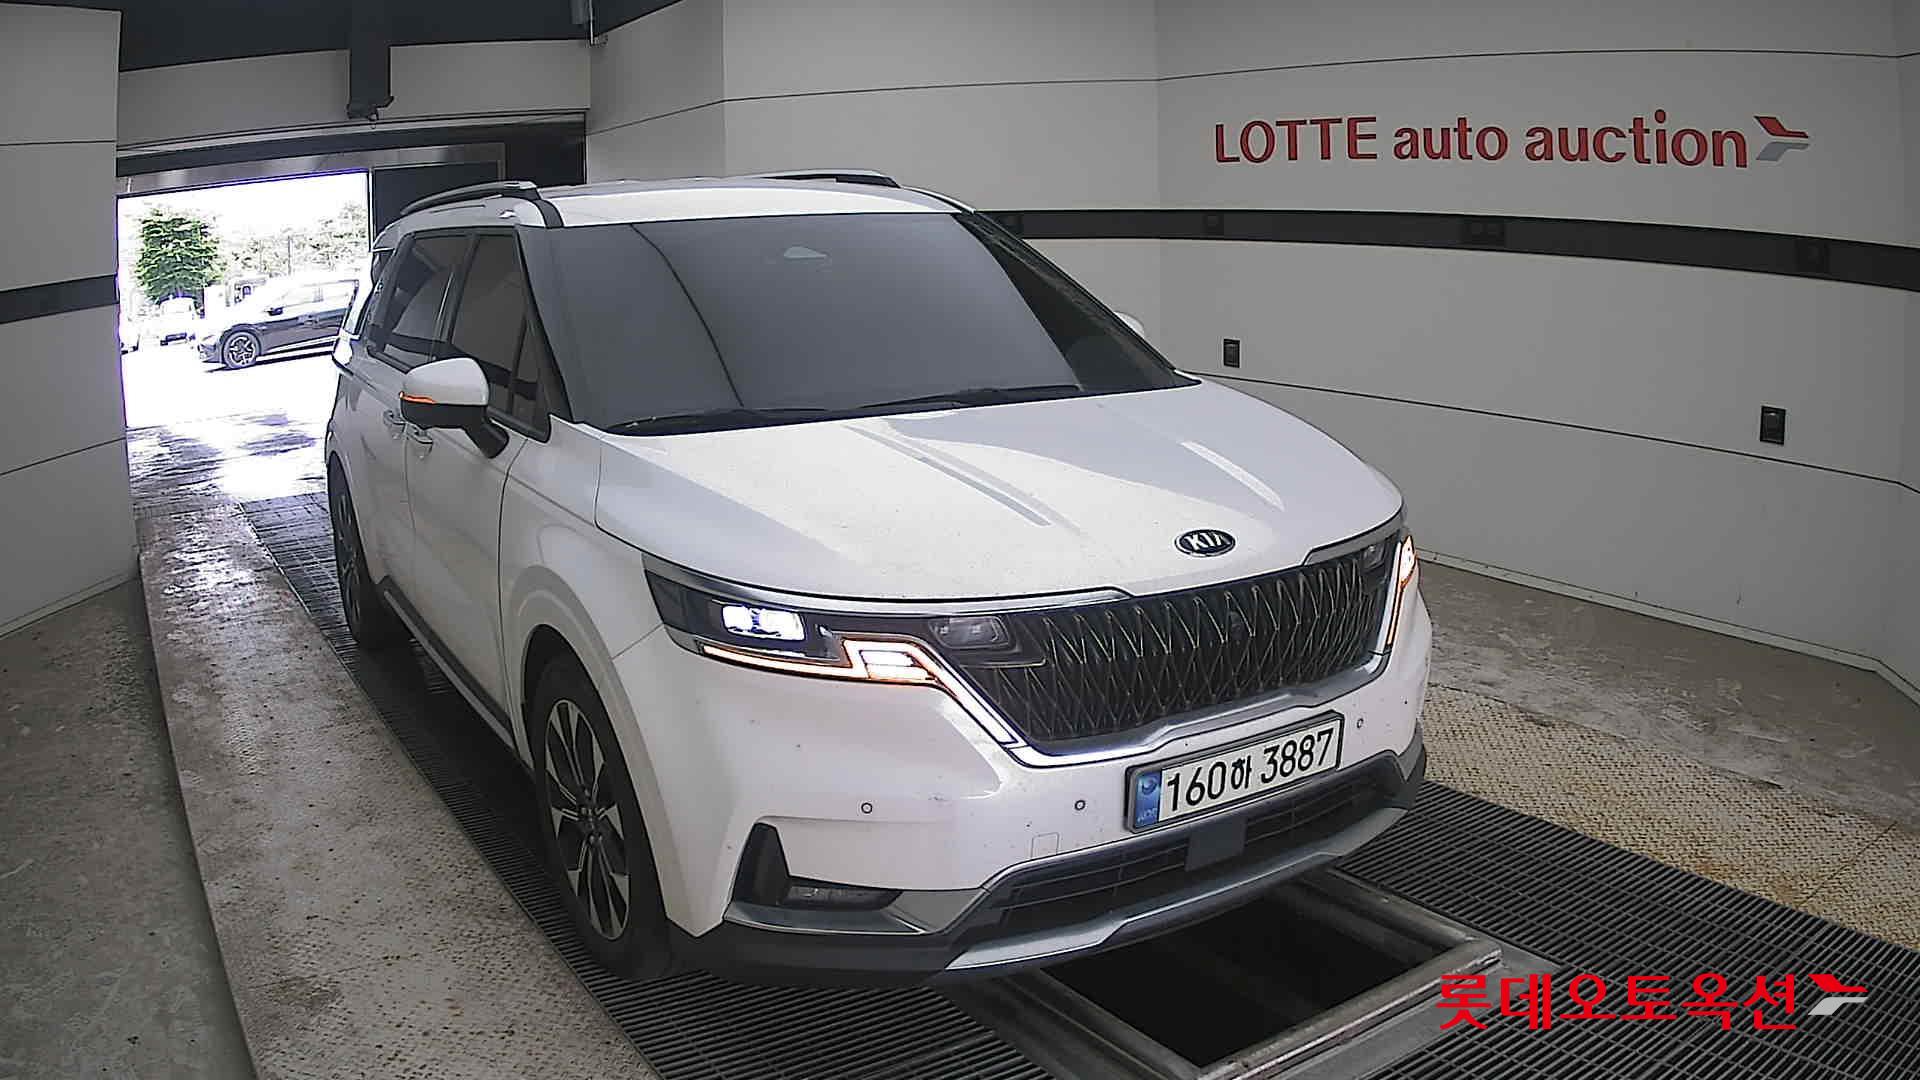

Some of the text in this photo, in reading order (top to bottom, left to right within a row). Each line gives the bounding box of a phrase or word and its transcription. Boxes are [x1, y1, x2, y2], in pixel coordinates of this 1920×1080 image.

[1215, 109, 1748, 168] LOTTE auto auction
[1184, 531, 1231, 551] KIA
[1167, 727, 1334, 811] 160하 3887
